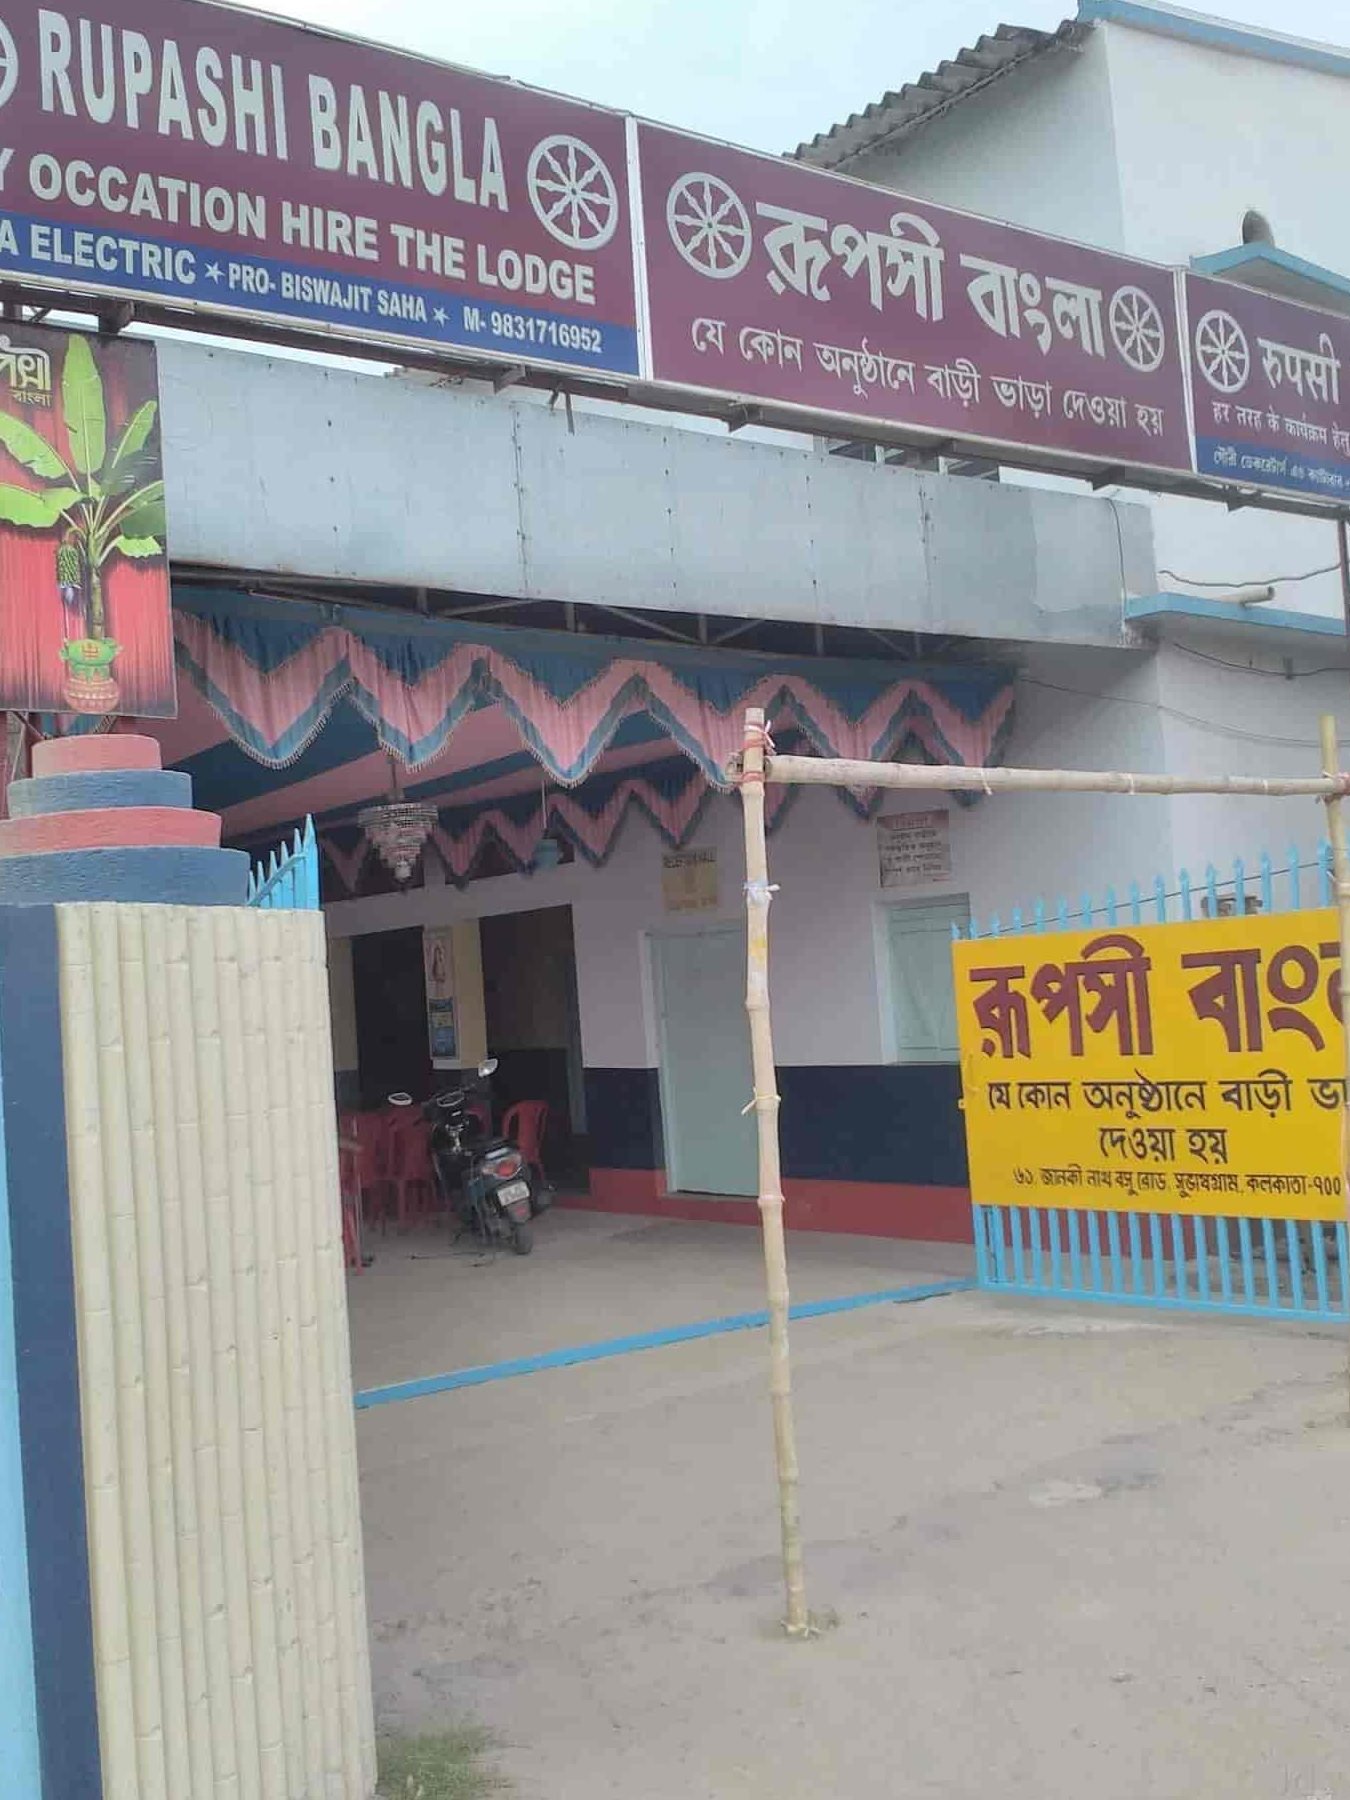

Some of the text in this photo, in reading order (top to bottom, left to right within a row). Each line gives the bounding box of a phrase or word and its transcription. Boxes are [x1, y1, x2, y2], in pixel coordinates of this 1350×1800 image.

[39, 9, 509, 213] RUPASHI BANGLA
[29, 152, 267, 238] OCCATION
[282, 201, 379, 261] HIRE
[391, 223, 465, 281] THE
[477, 244, 596, 306] LODGE
[31, 224, 196, 285] ELECTRIC
[228, 262, 276, 296] PRO-
[281, 273, 373, 314] BISWAJIT
[377, 292, 427, 322] SAHA
[490, 313, 602, 354] 9831716952
[756, 201, 1105, 358] রূপসী বাংলা
[692, 318, 1164, 437] যে কোন অনুষ্ঠানে বাড়ী ভাড়া দেওয়া হয়
[969, 934, 1342, 1059] রূপসী বাং
[1018, 1082, 1071, 1110] কোন
[1082, 1068, 1206, 1119] অনুষ্ঠানে
[1219, 1068, 1292, 1117] বাড়ী
[1100, 1128, 1228, 1164] দেওয়া হয়
